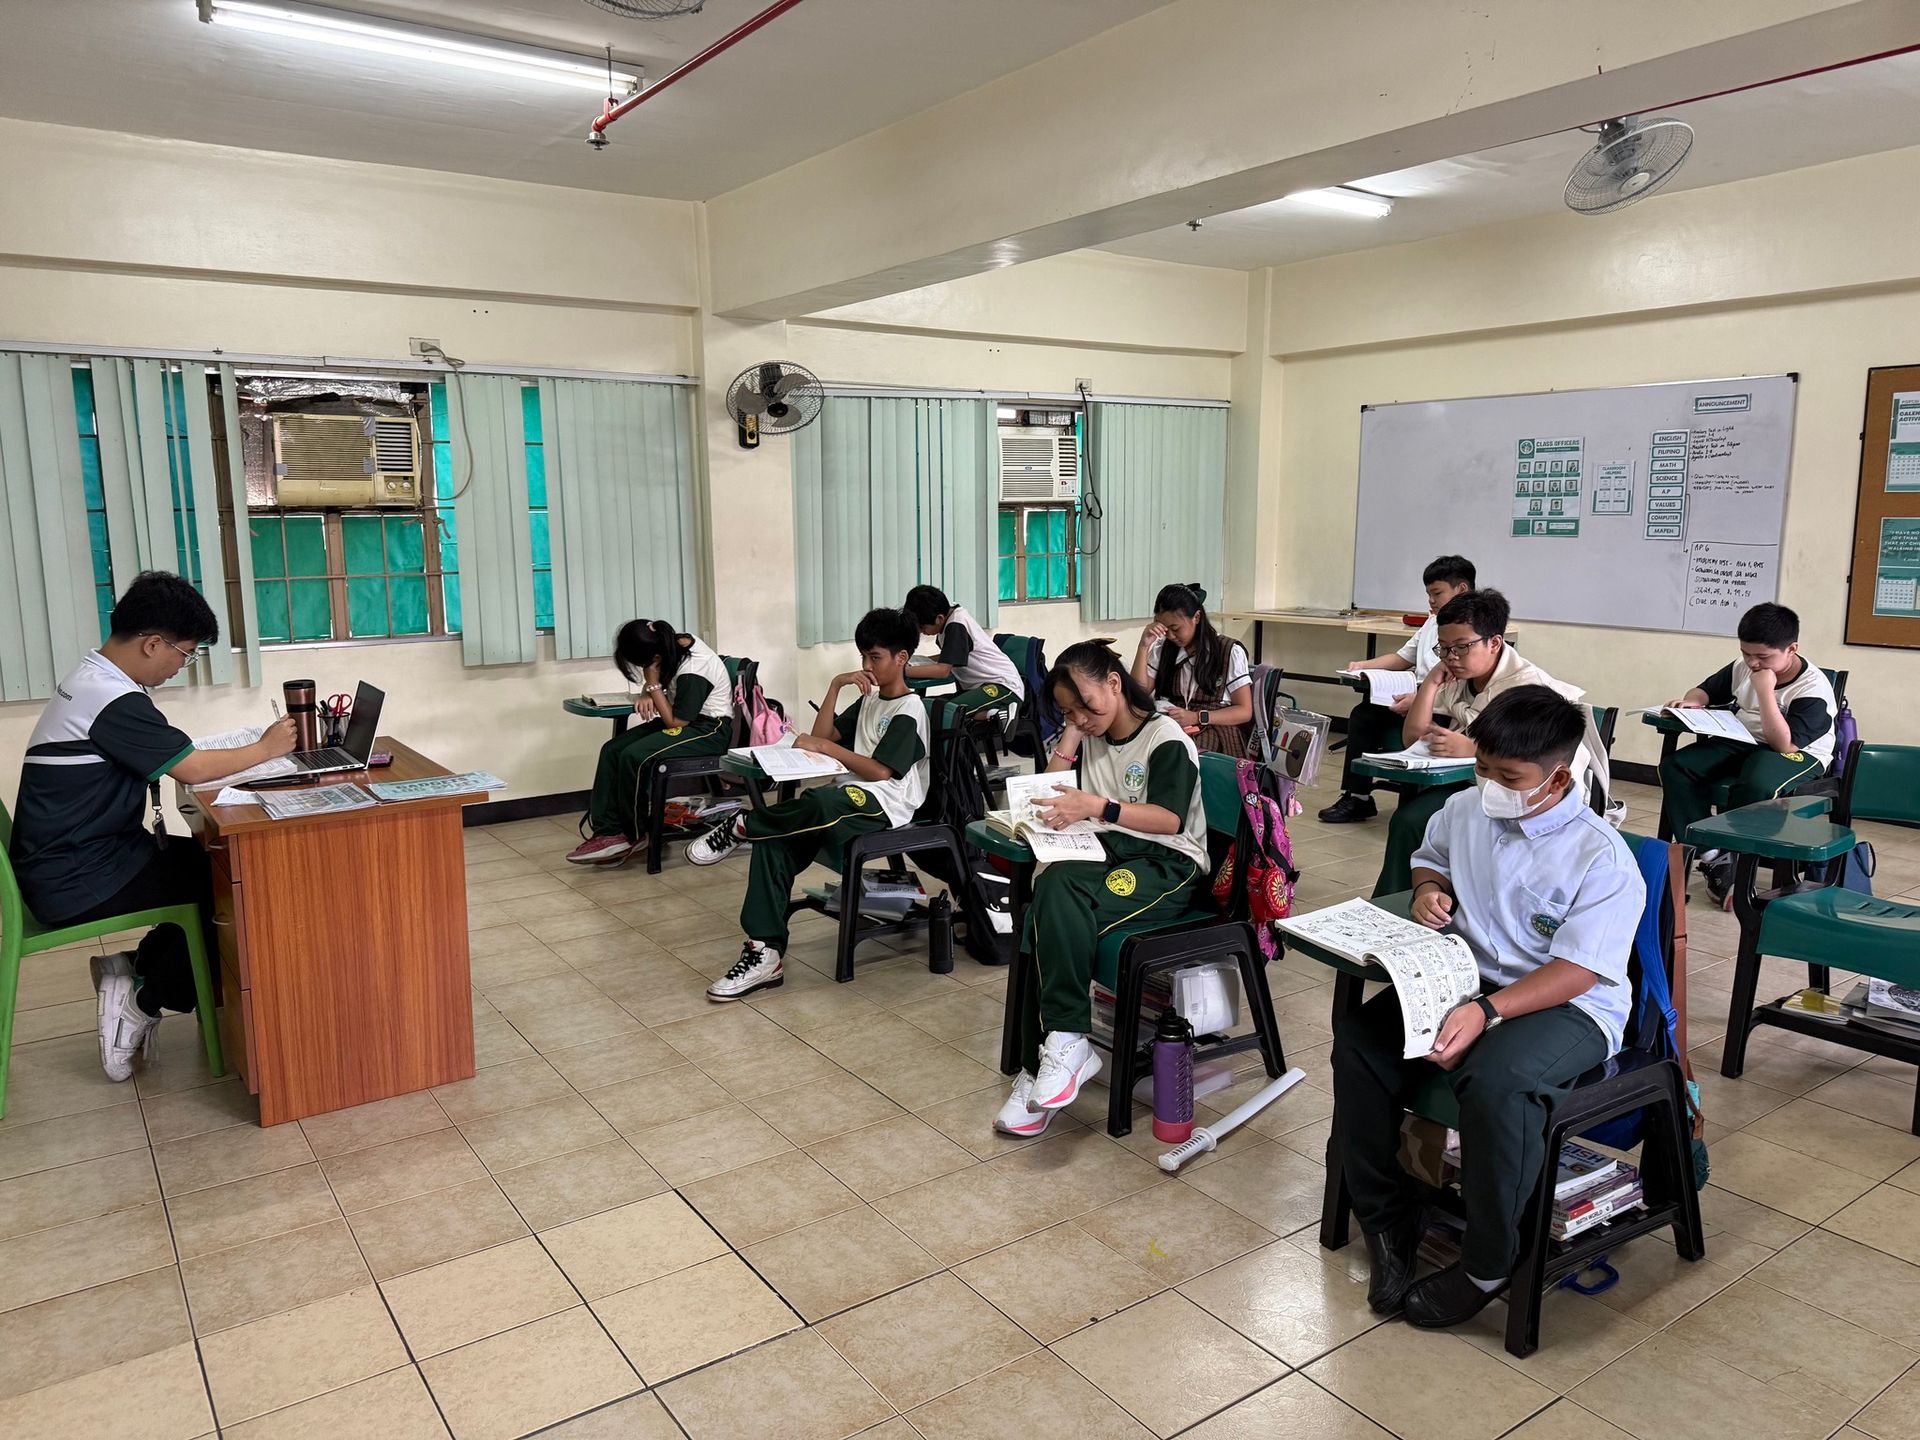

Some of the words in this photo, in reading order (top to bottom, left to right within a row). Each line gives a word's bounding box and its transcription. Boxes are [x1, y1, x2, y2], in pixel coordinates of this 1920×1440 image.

[1699, 399, 1746, 407] ANNOUNCEMENT
[1575, 1215, 1588, 1226] MATH
[1588, 1209, 1604, 1220] WORLD
